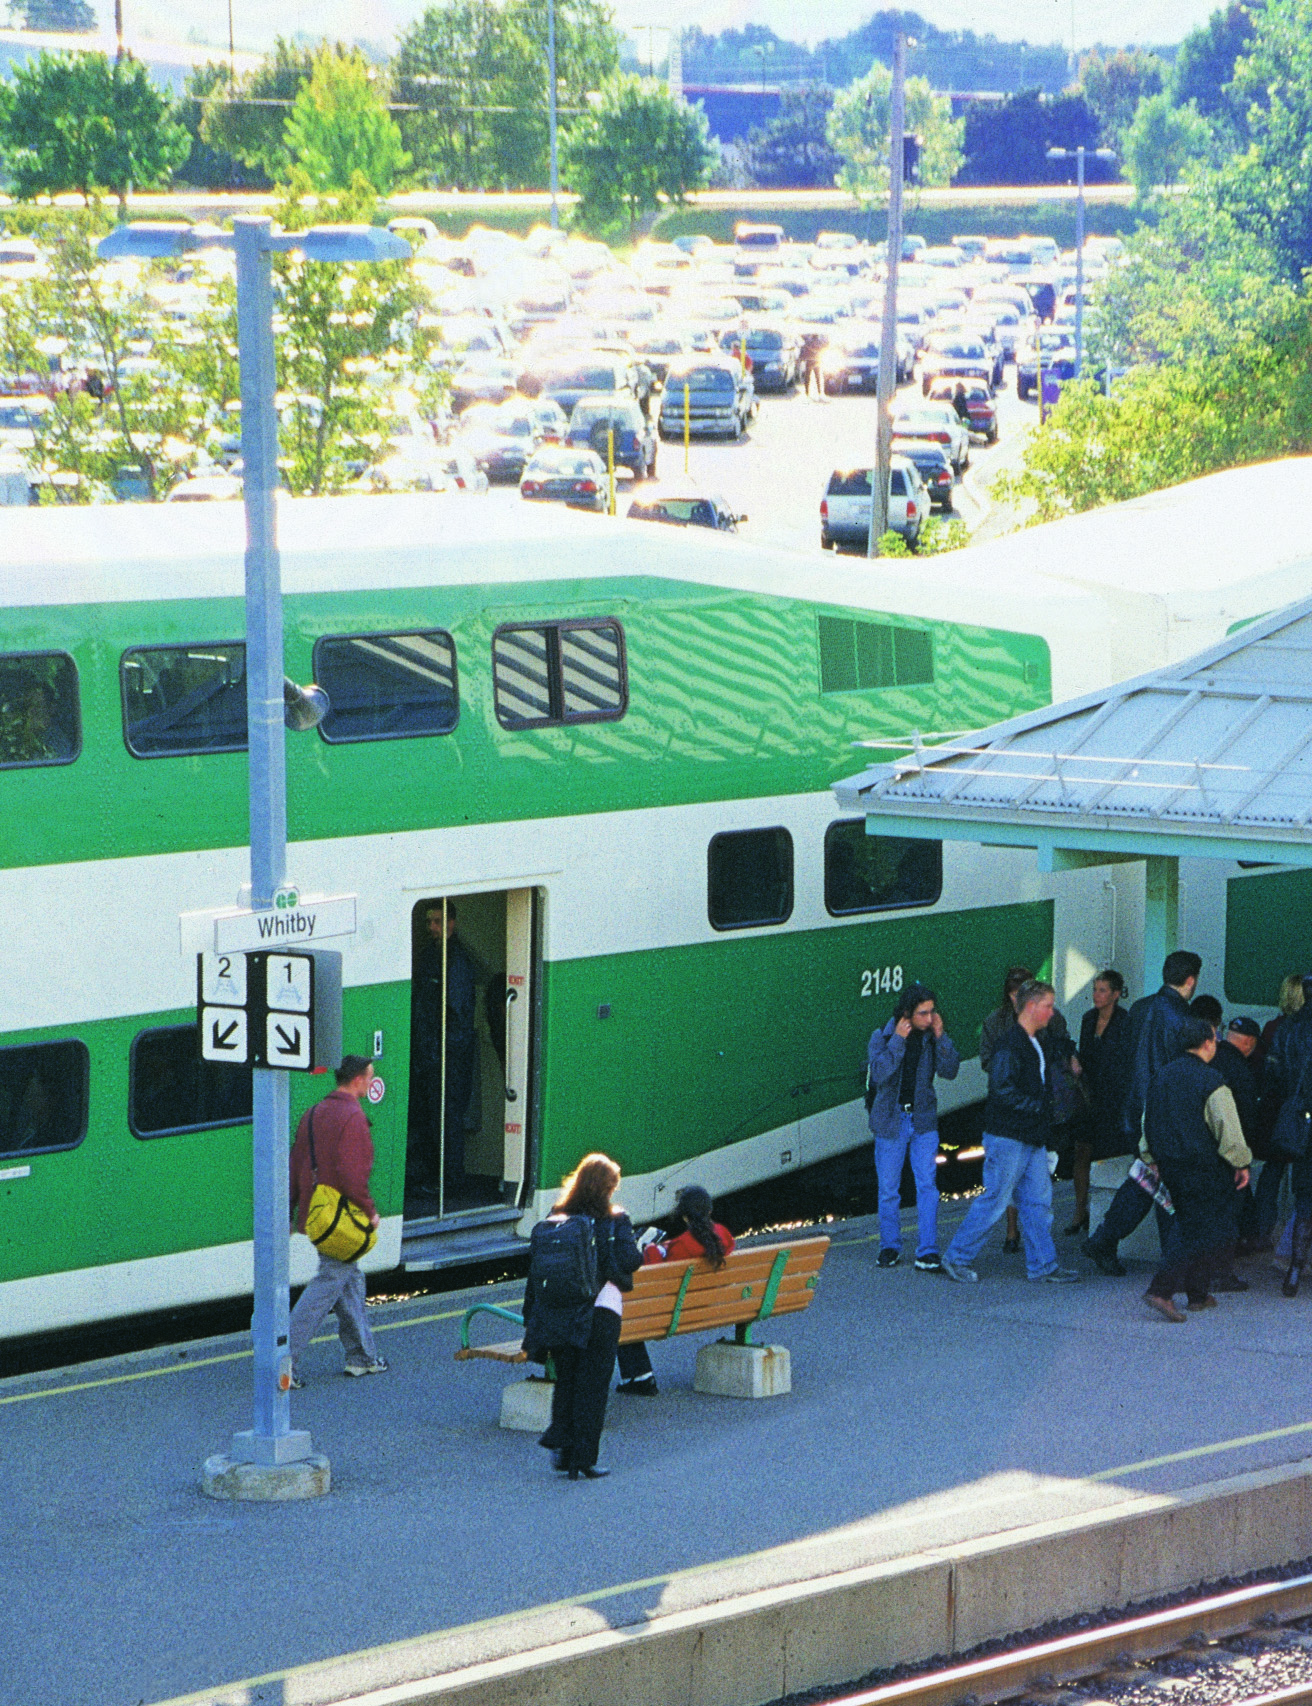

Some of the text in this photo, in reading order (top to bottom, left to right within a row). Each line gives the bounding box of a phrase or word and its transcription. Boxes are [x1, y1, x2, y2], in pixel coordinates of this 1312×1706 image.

[258, 912, 316, 938] Whitby
[218, 957, 232, 979] 2
[283, 962, 293, 984] 1
[861, 964, 903, 997] 2148
